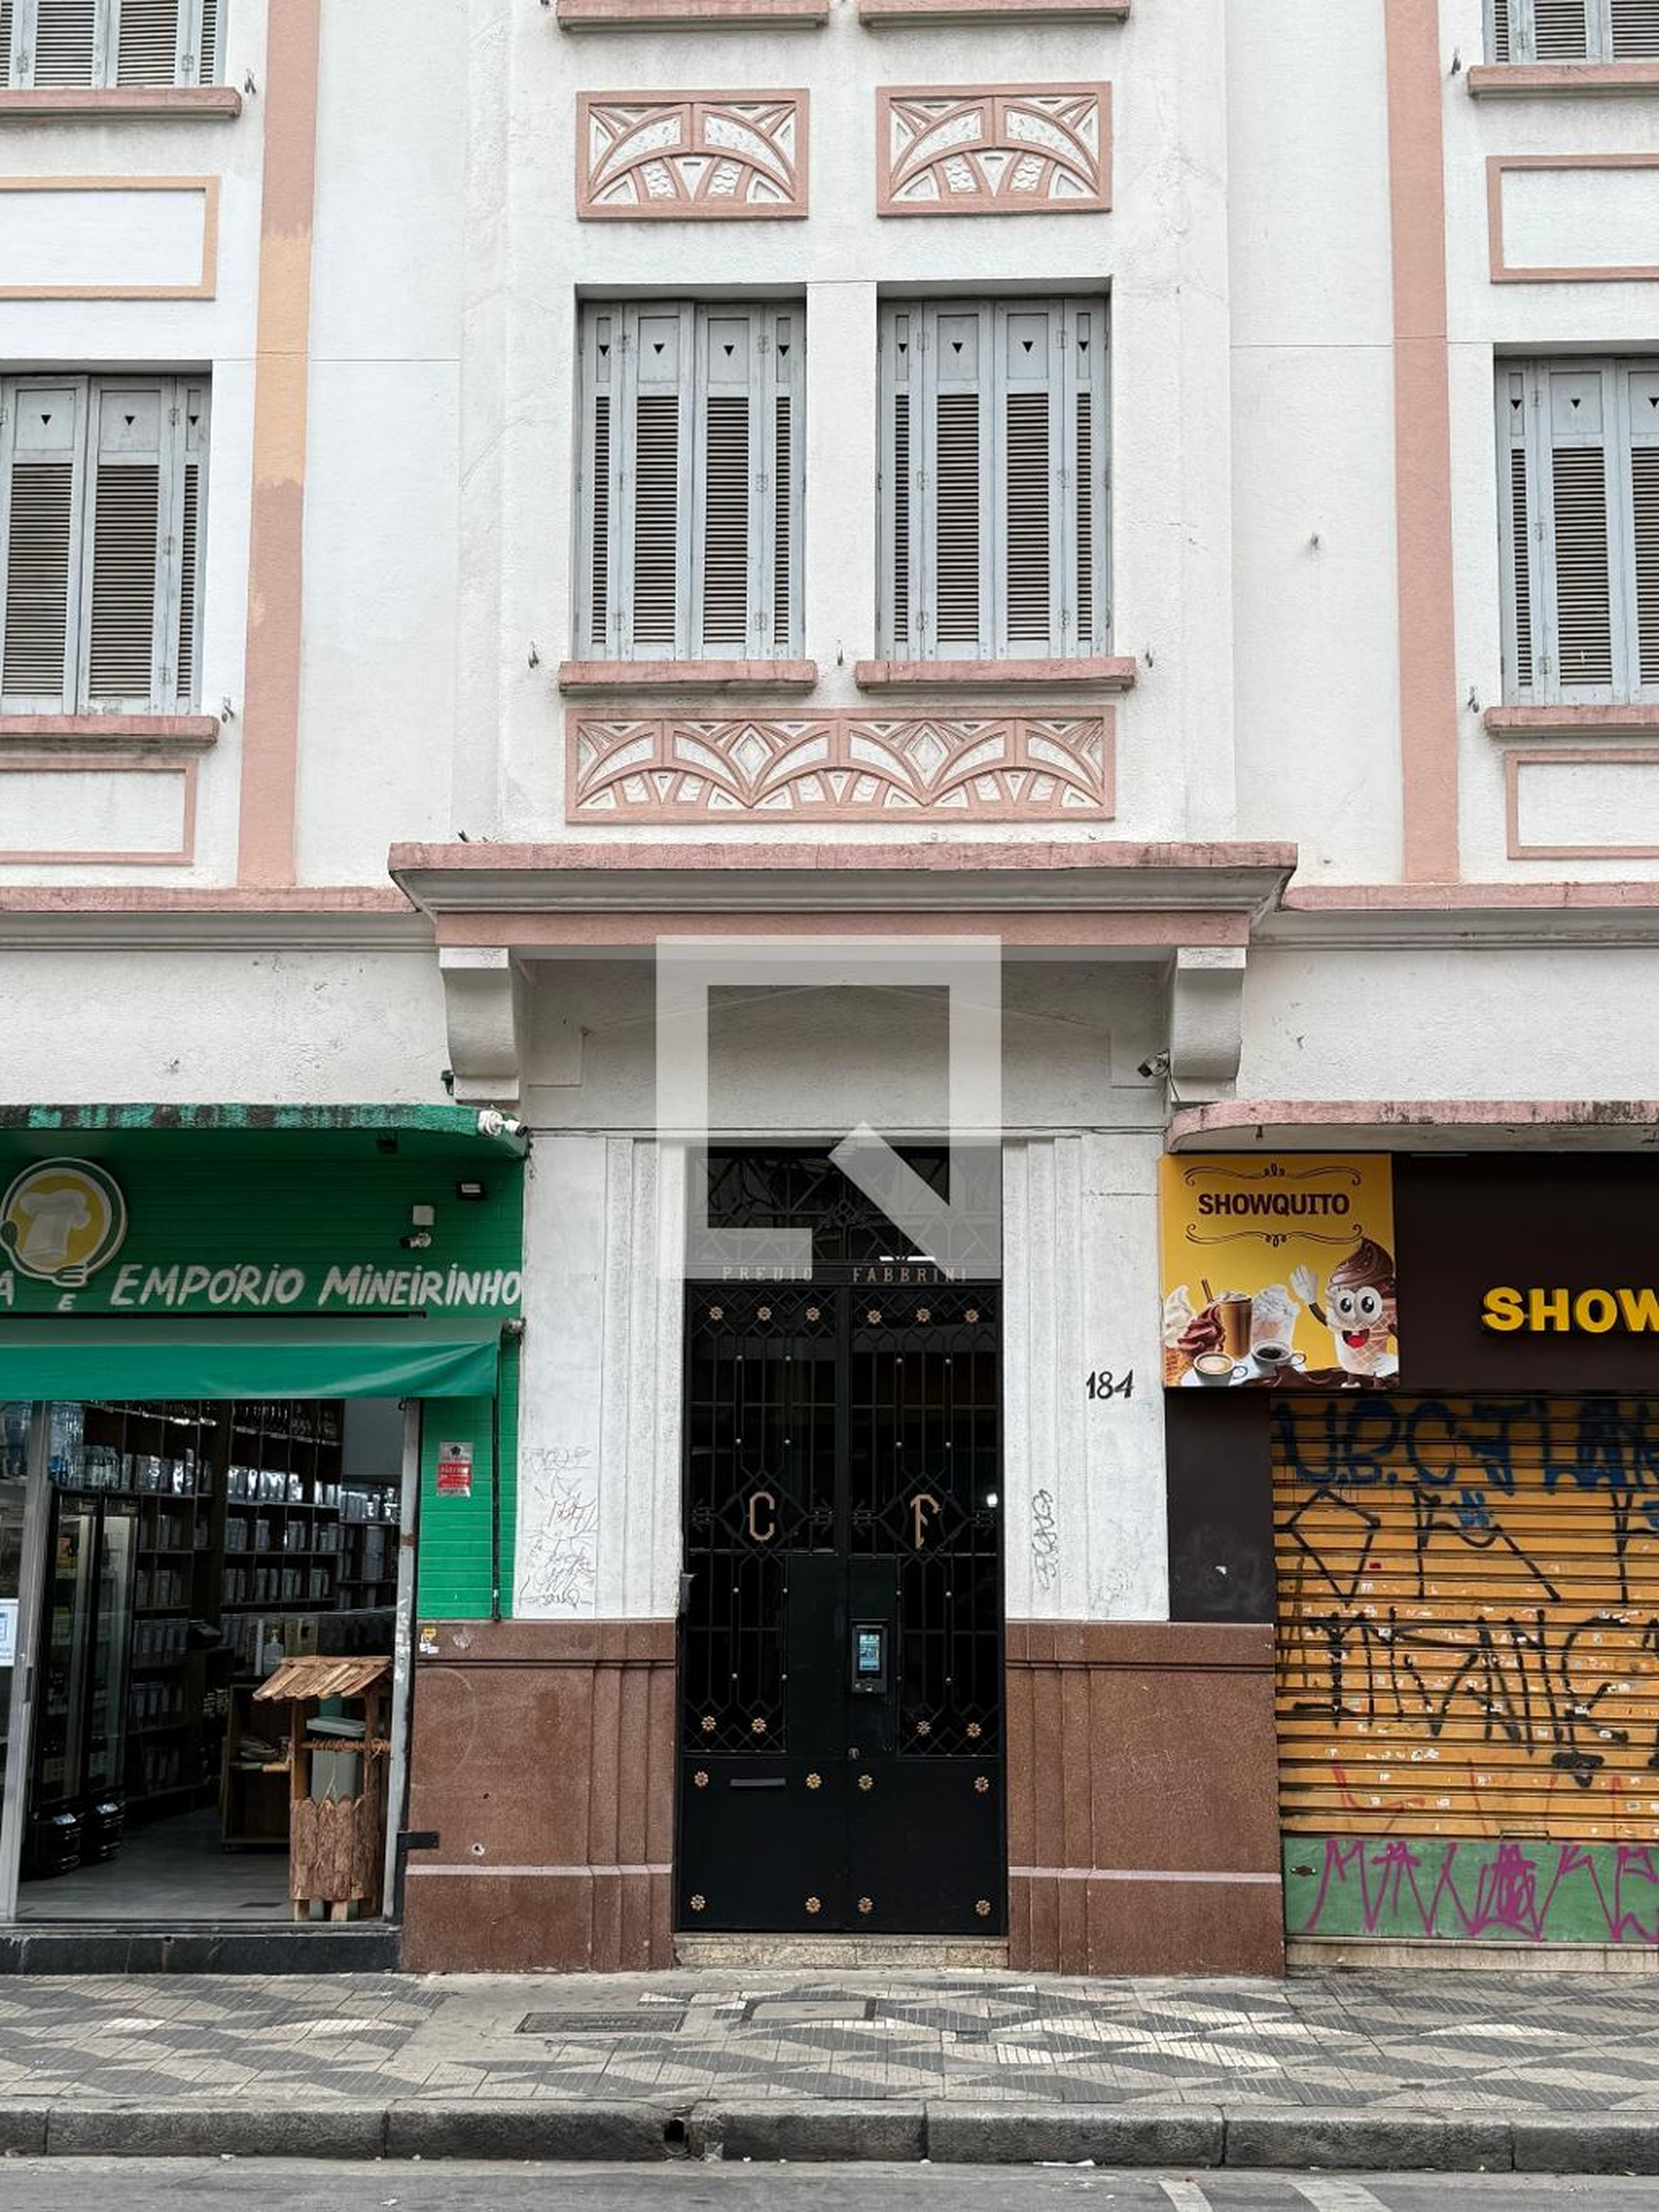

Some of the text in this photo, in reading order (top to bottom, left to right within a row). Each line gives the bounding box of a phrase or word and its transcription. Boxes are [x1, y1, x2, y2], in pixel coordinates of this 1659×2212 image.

[1198, 1194, 1350, 1216] SHOWQUITO
[853, 1267, 966, 1282] FABBRINI
[1086, 1369, 1134, 1399] 184
